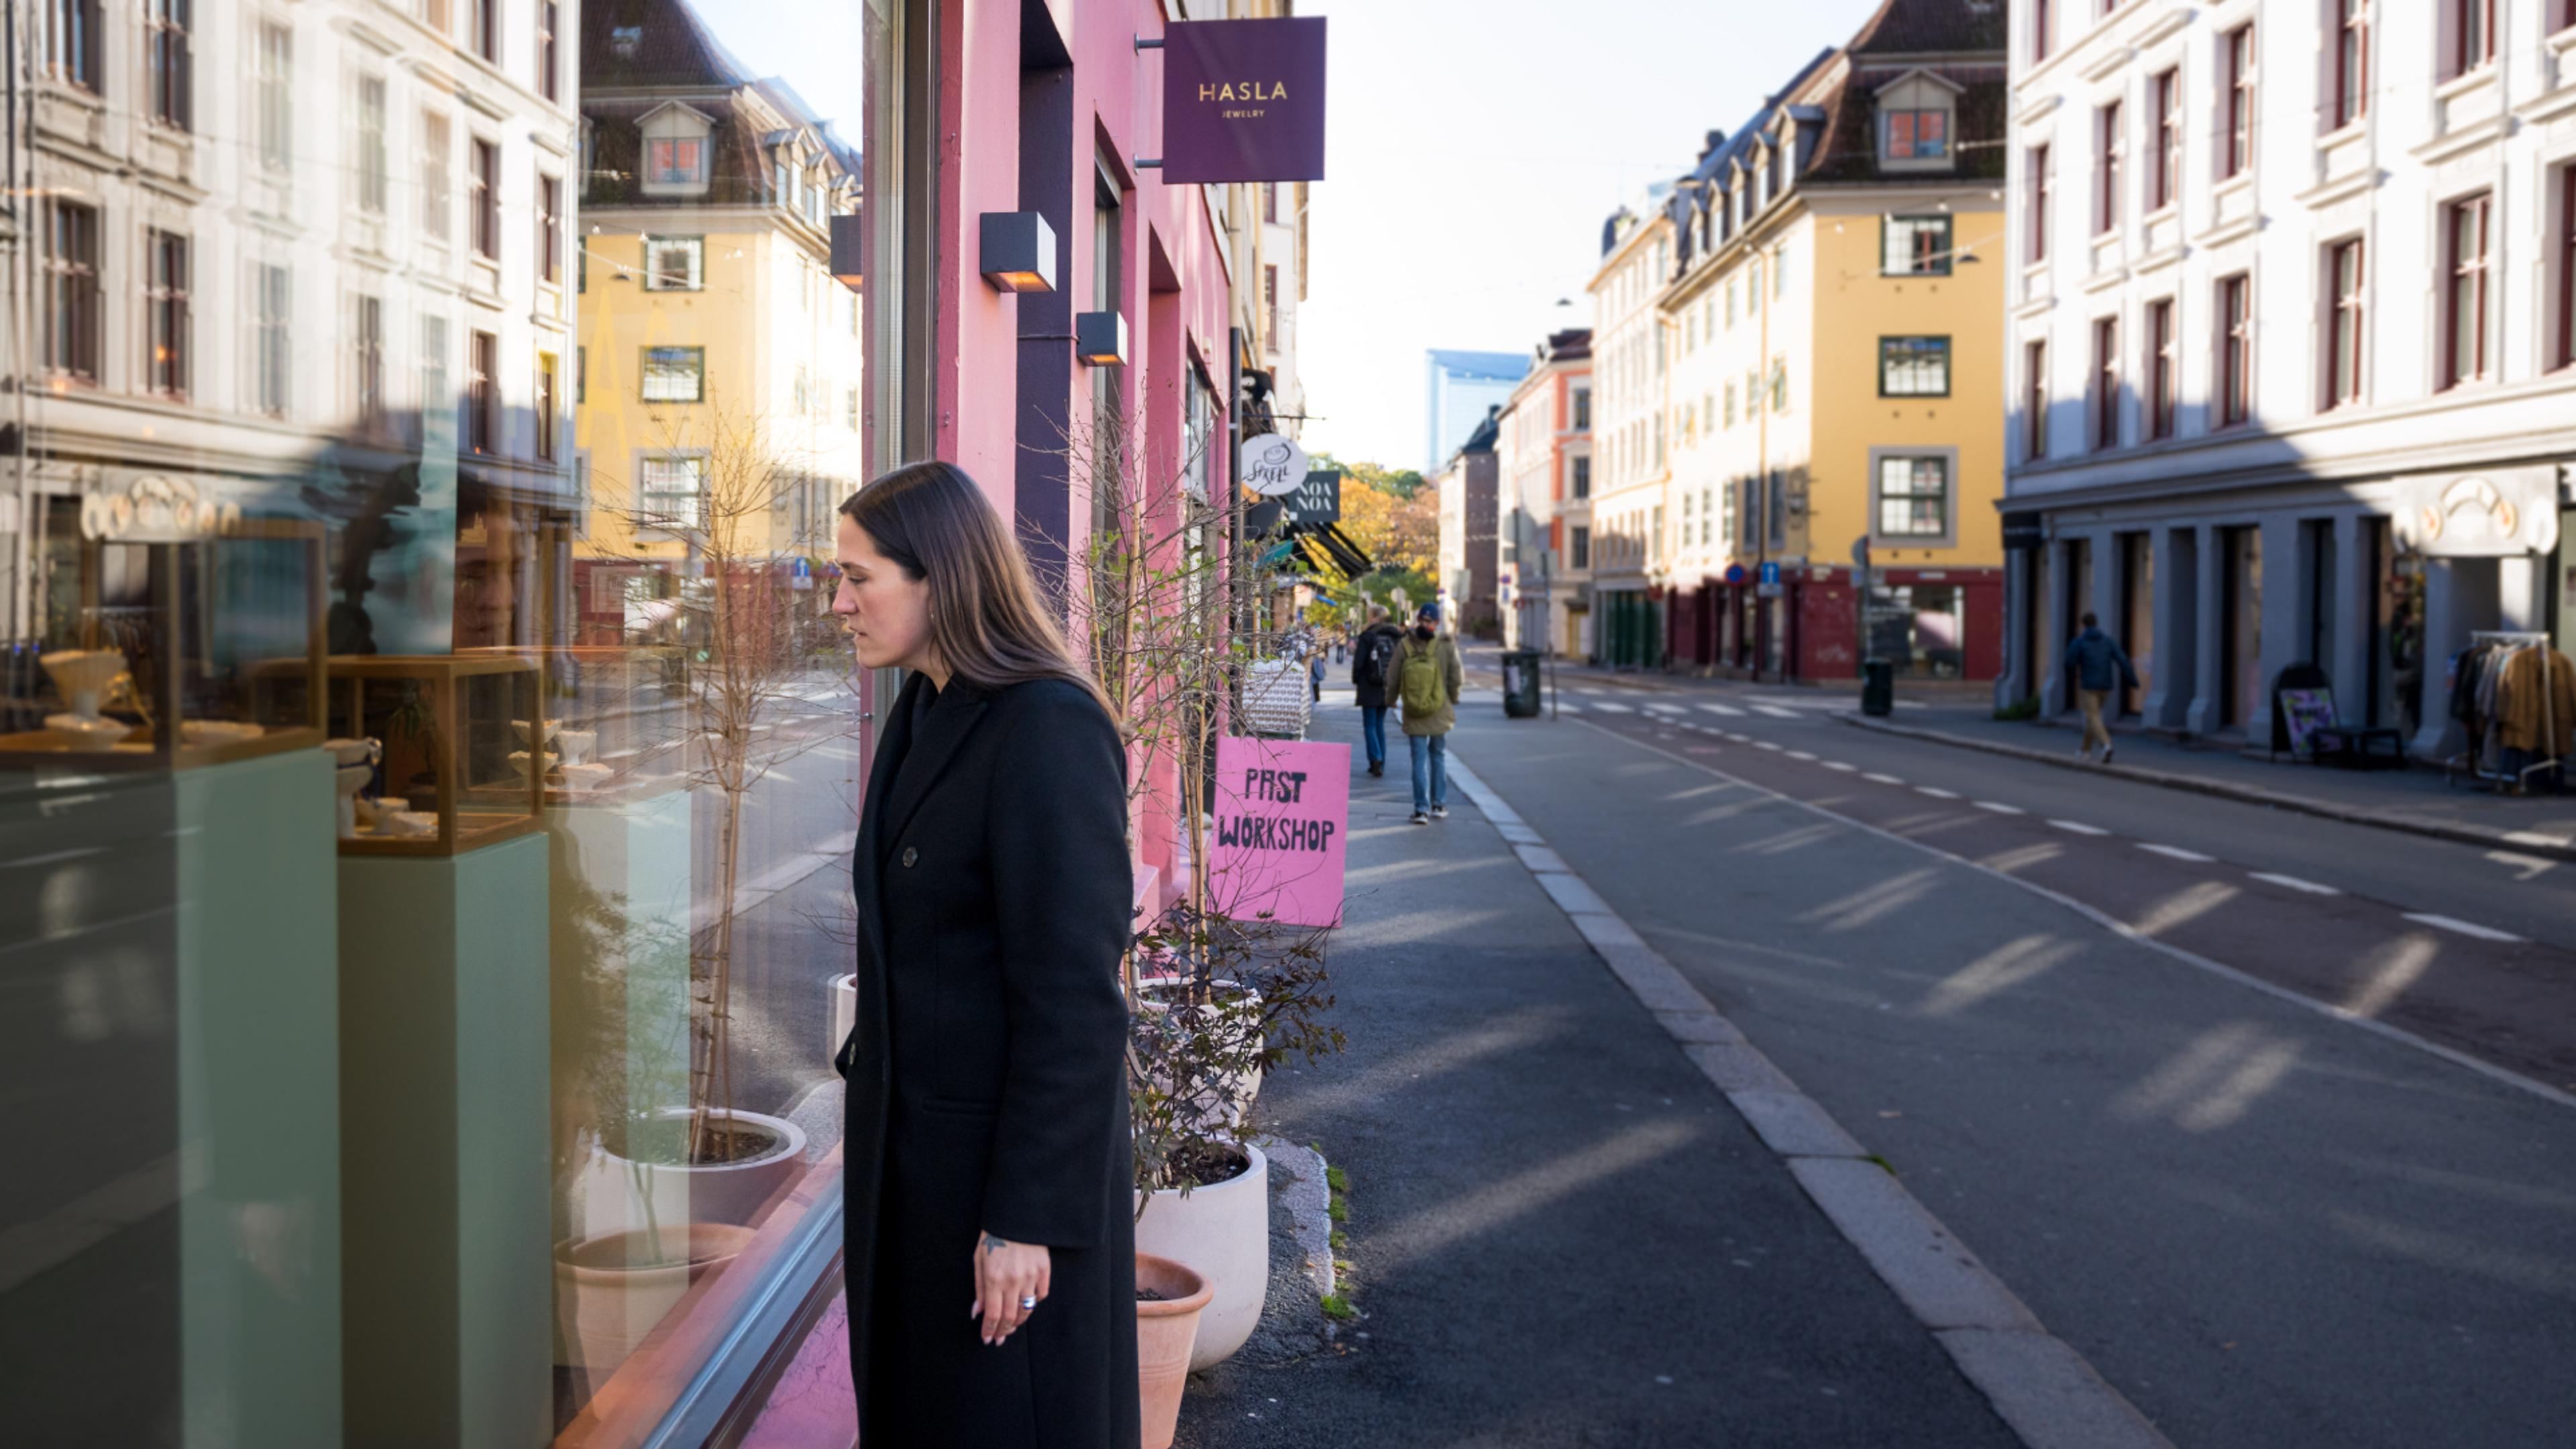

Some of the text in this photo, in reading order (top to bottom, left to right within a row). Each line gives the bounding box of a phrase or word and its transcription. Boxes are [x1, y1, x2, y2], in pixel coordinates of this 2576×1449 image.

[1199, 81, 1287, 101] HASLA
[1222, 109, 1265, 119] JEWELRY
[1297, 482, 1332, 496] NOA
[1297, 497, 1332, 511] NOA
[1244, 768, 1307, 803] PAST
[1218, 815, 1334, 853] WORKSHOP
